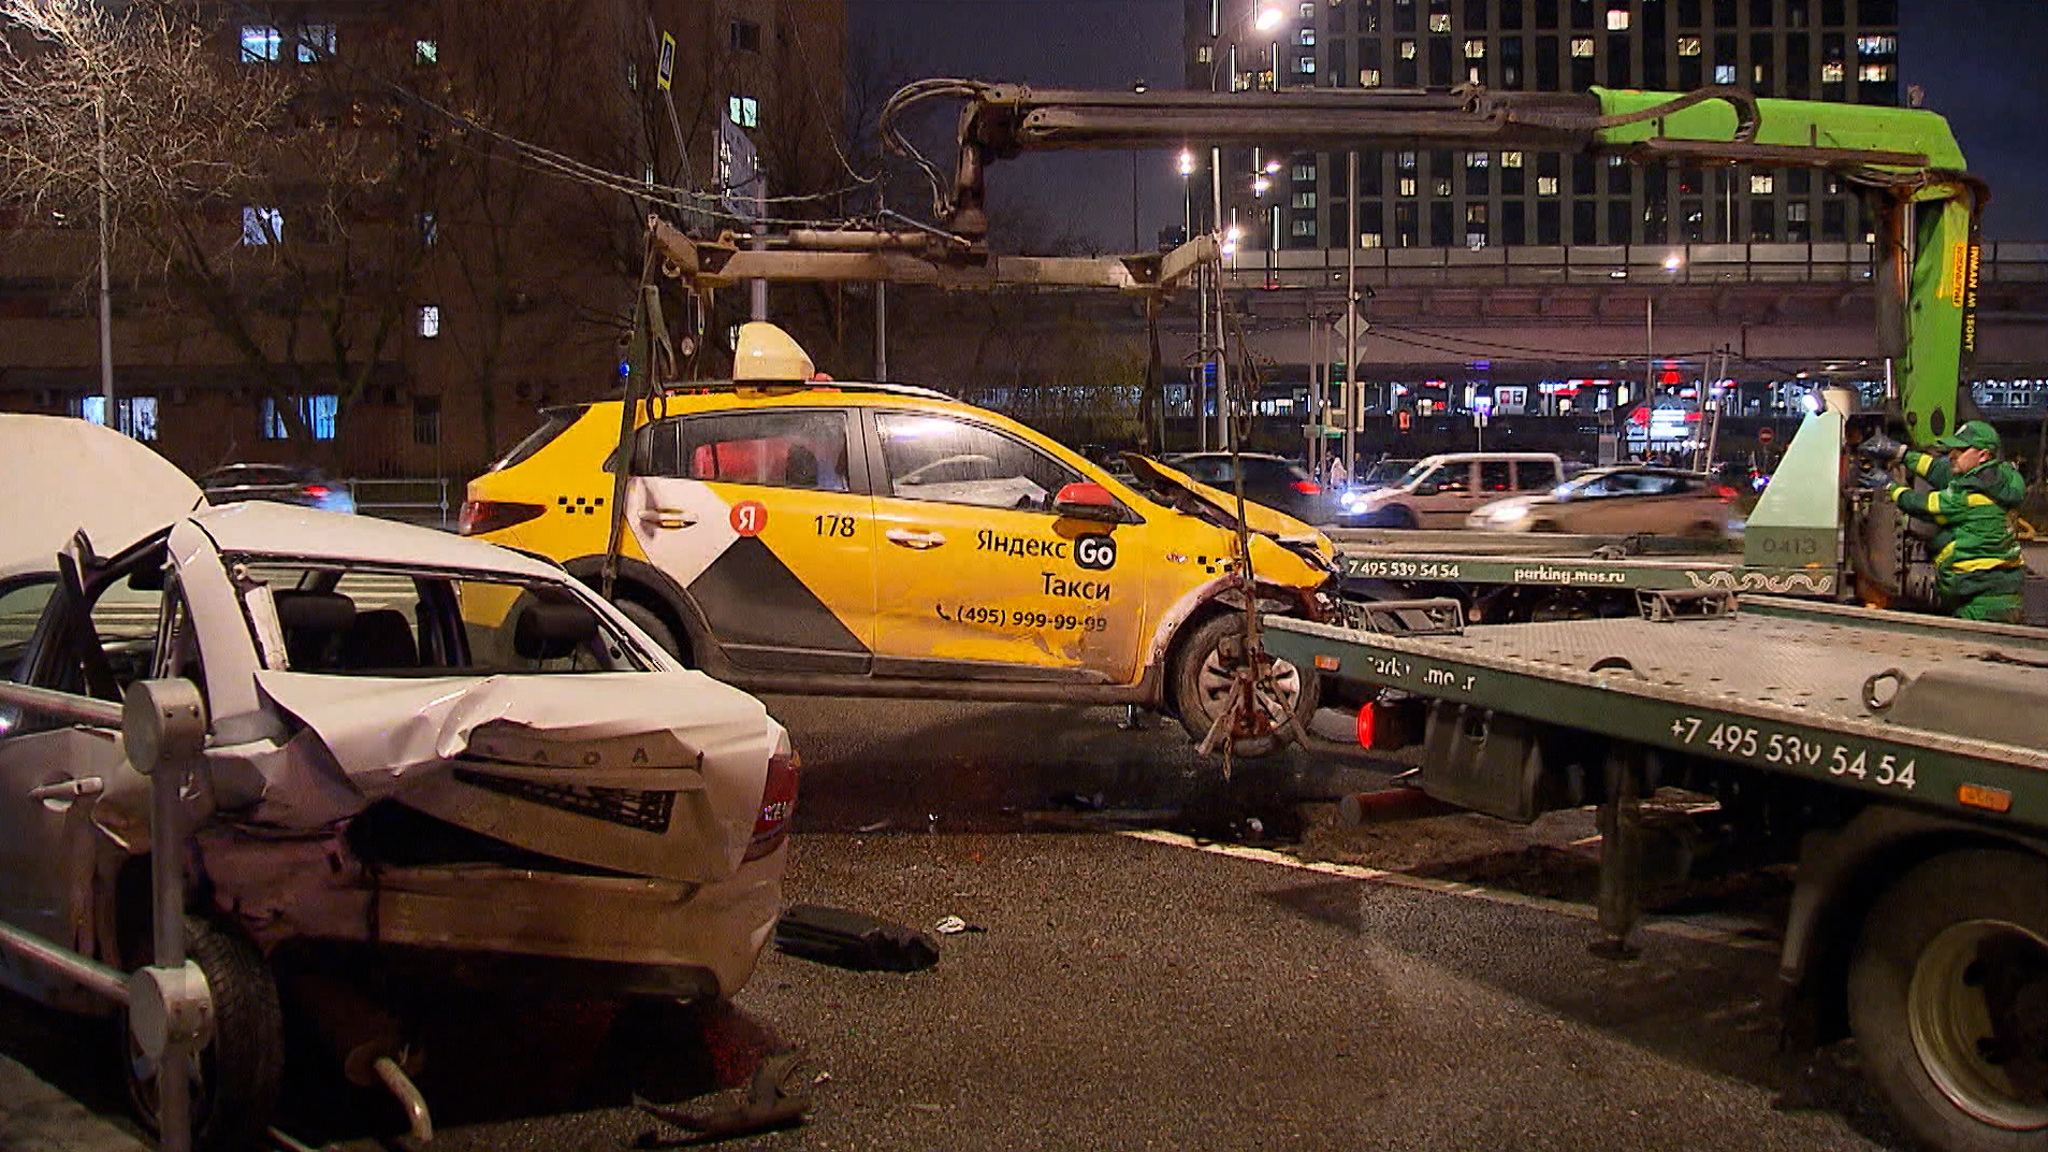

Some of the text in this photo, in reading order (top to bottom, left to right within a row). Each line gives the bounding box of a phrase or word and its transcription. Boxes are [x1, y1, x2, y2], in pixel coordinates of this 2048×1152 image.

[738, 506, 755, 531] Я
[814, 515, 855, 537] 178
[977, 530, 1113, 565] Яндекс Go
[1762, 537, 1817, 555] 0413
[1360, 562, 1387, 575] 495
[1390, 562, 1417, 576] 539
[1419, 564, 1438, 577] 54
[1440, 564, 1460, 578] 54
[1514, 564, 1625, 584] parking.mos.ru
[1041, 571, 1111, 602] Такси
[957, 606, 1107, 632] (495) 999-99-99
[1671, 717, 1702, 743] +7
[1707, 724, 1758, 757] 495
[1830, 747, 1867, 779] 54
[1877, 756, 1916, 789] 54
